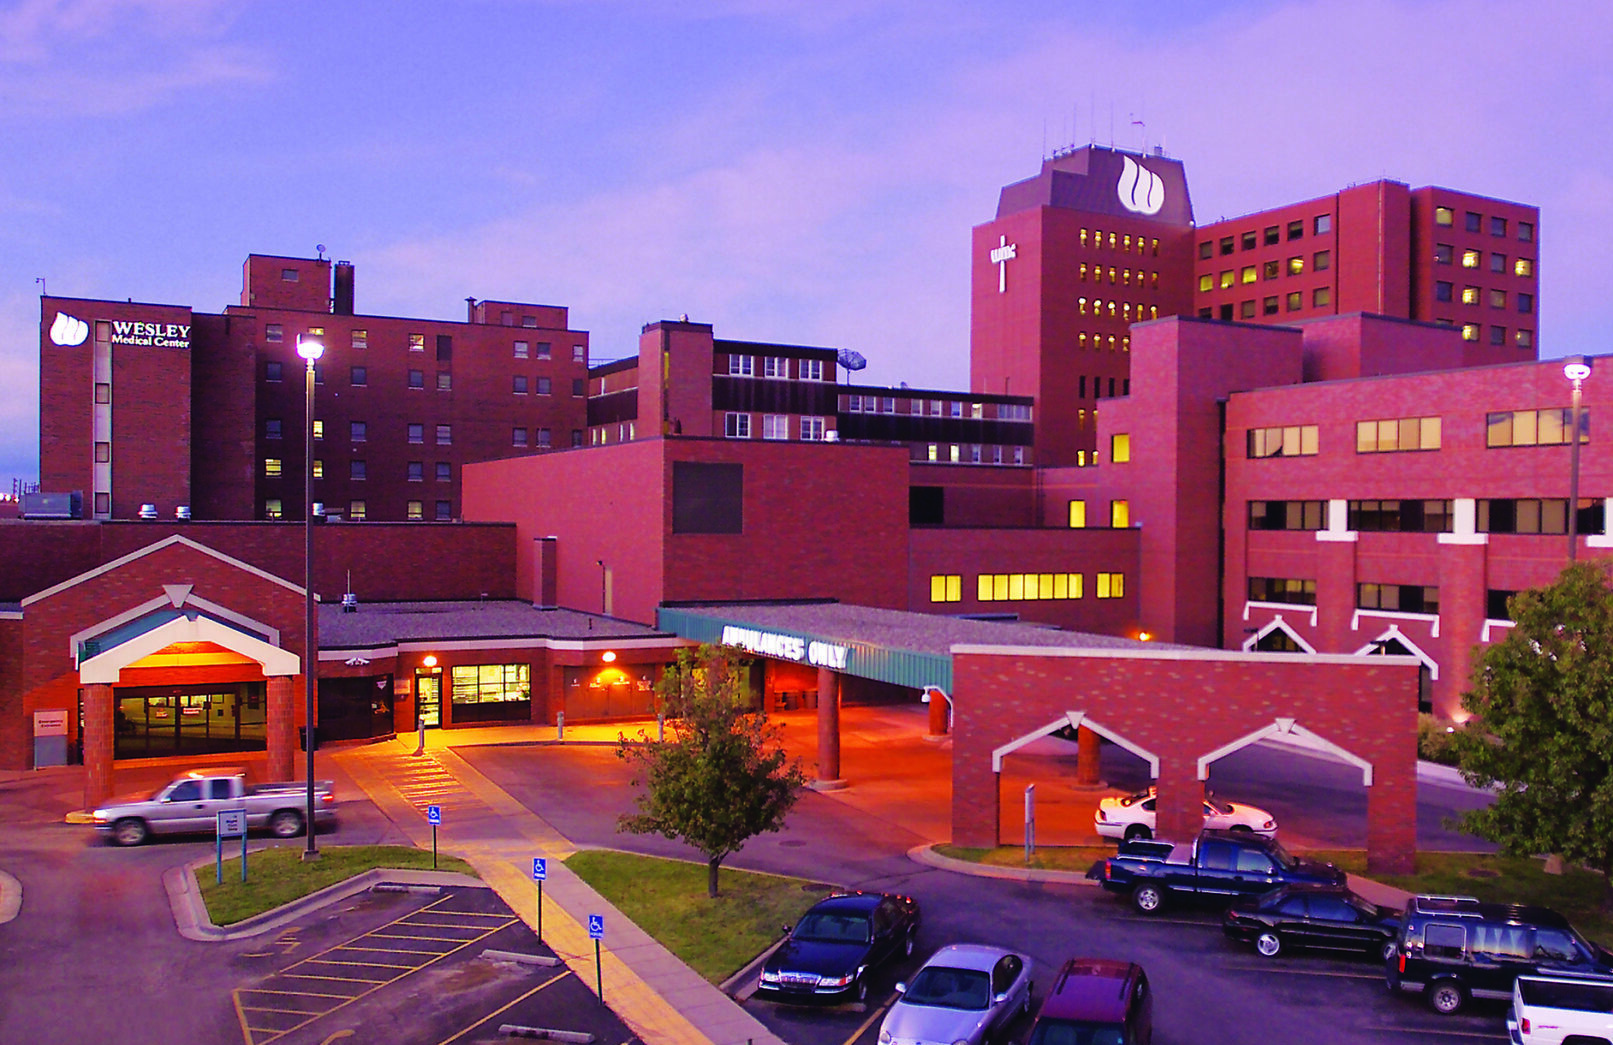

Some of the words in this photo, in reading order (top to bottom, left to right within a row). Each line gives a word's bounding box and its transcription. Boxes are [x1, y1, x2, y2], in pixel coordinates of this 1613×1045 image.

[112, 321, 191, 338] WESLEY
[111, 334, 153, 346] Medical
[154, 336, 190, 348] Center
[721, 625, 805, 661] AMBULANCES
[808, 640, 847, 669] ONLY
